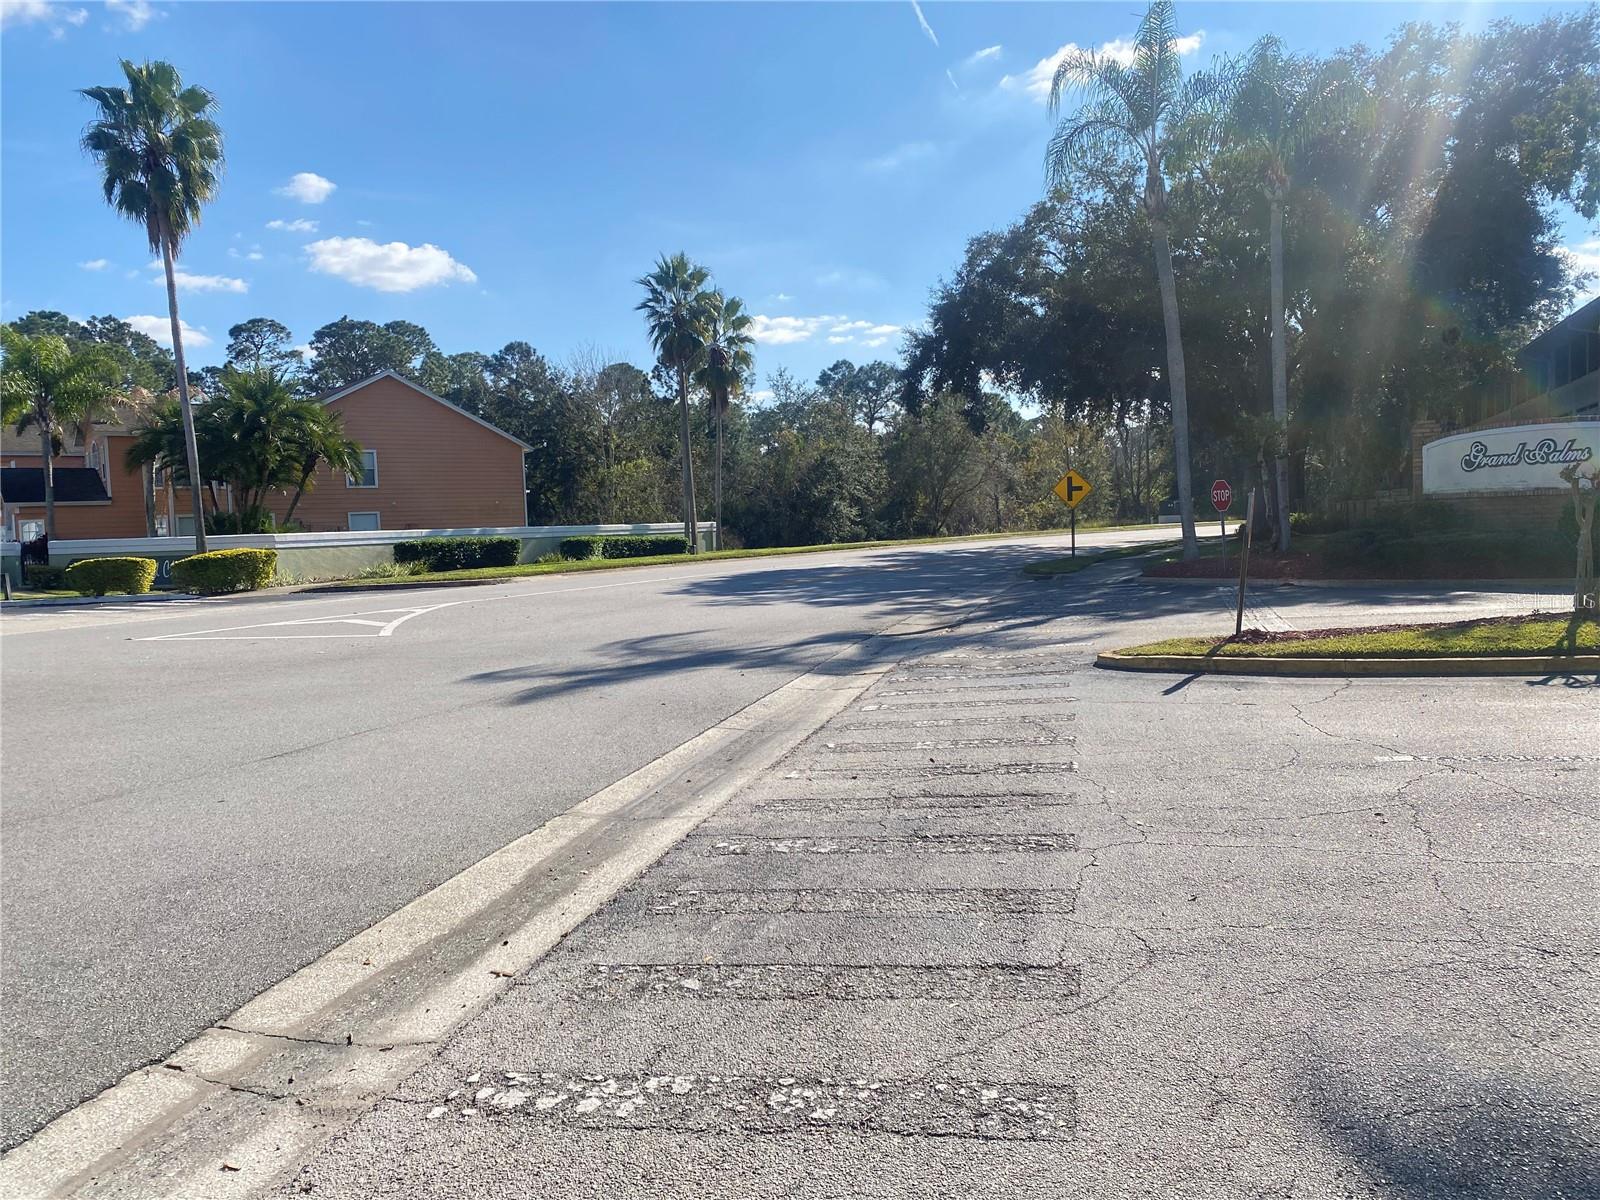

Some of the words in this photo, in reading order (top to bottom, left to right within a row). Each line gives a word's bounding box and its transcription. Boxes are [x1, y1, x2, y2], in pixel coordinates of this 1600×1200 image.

[1461, 441, 1526, 472] Grand
[1523, 439, 1592, 465] Palms
[1213, 489, 1230, 502] STOP
